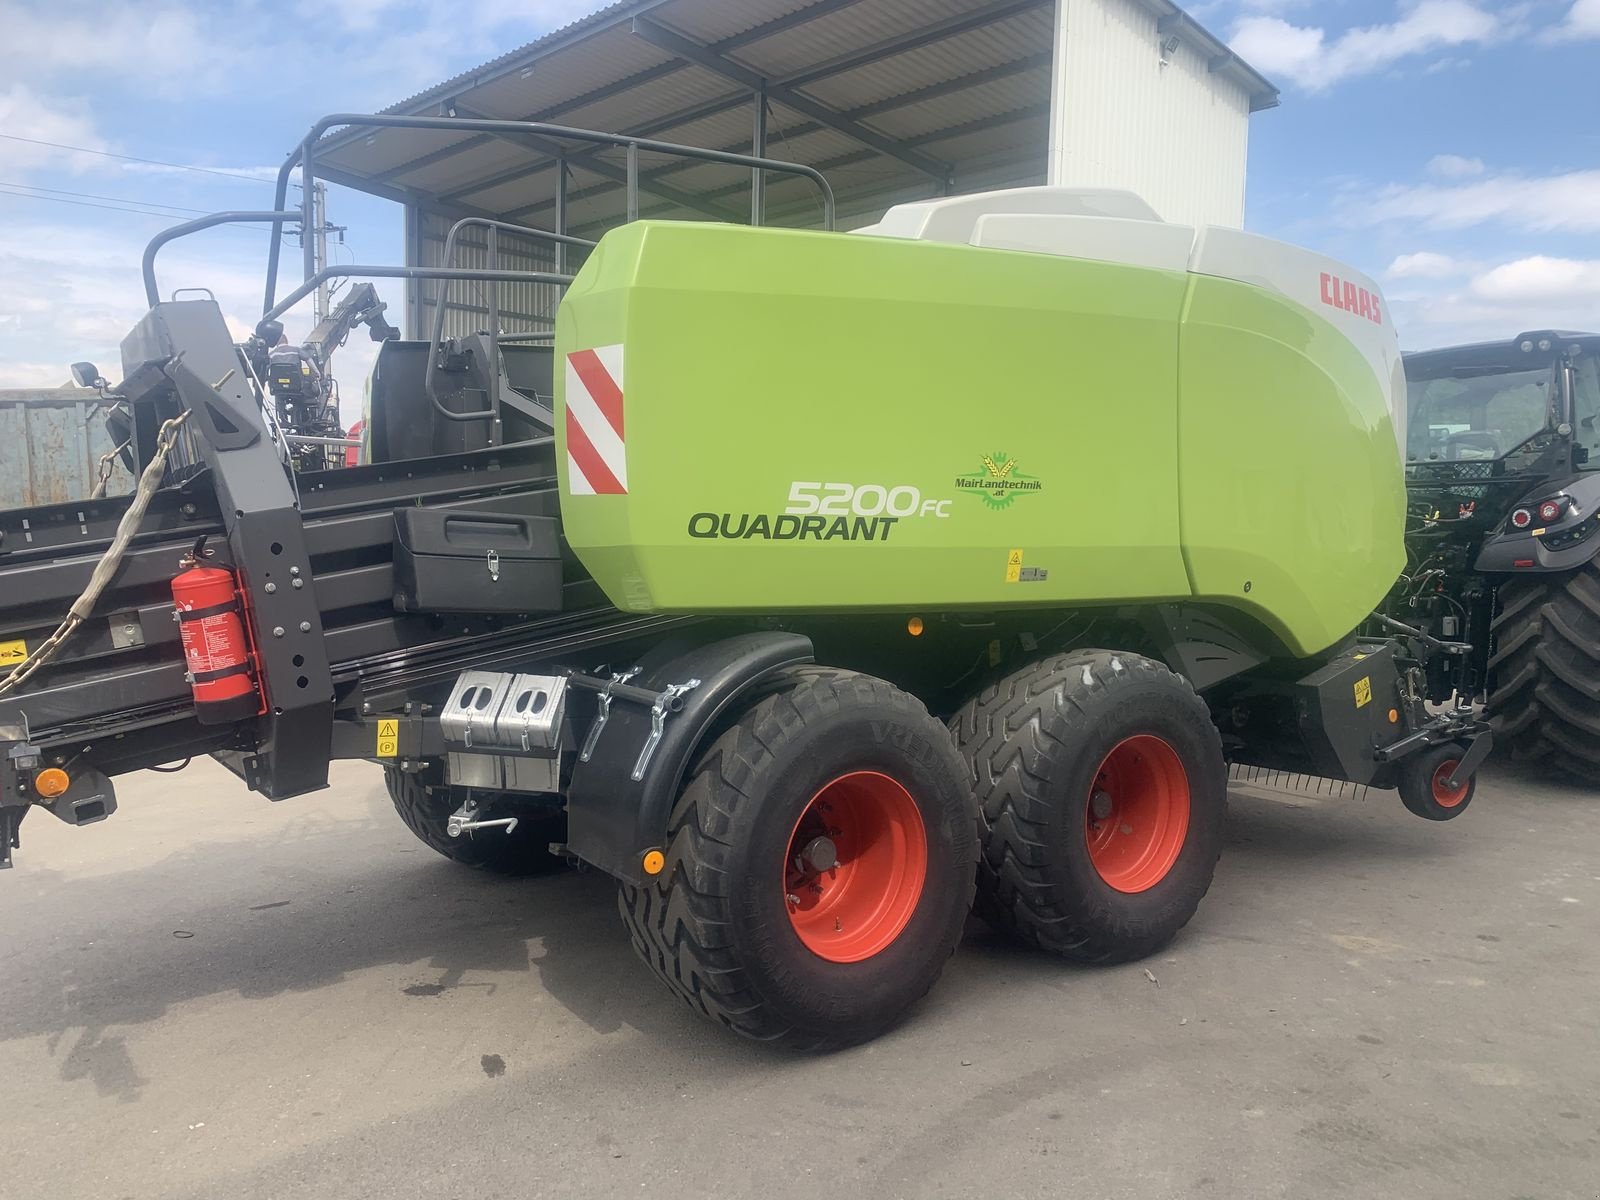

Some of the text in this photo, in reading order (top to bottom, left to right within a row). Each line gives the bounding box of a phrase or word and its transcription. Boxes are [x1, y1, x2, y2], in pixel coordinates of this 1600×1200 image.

[1320, 271, 1382, 326] CLAAS
[784, 481, 920, 518] 5200
[955, 478, 1042, 490] MairLandtechnik
[687, 512, 899, 541] QUADRANT
